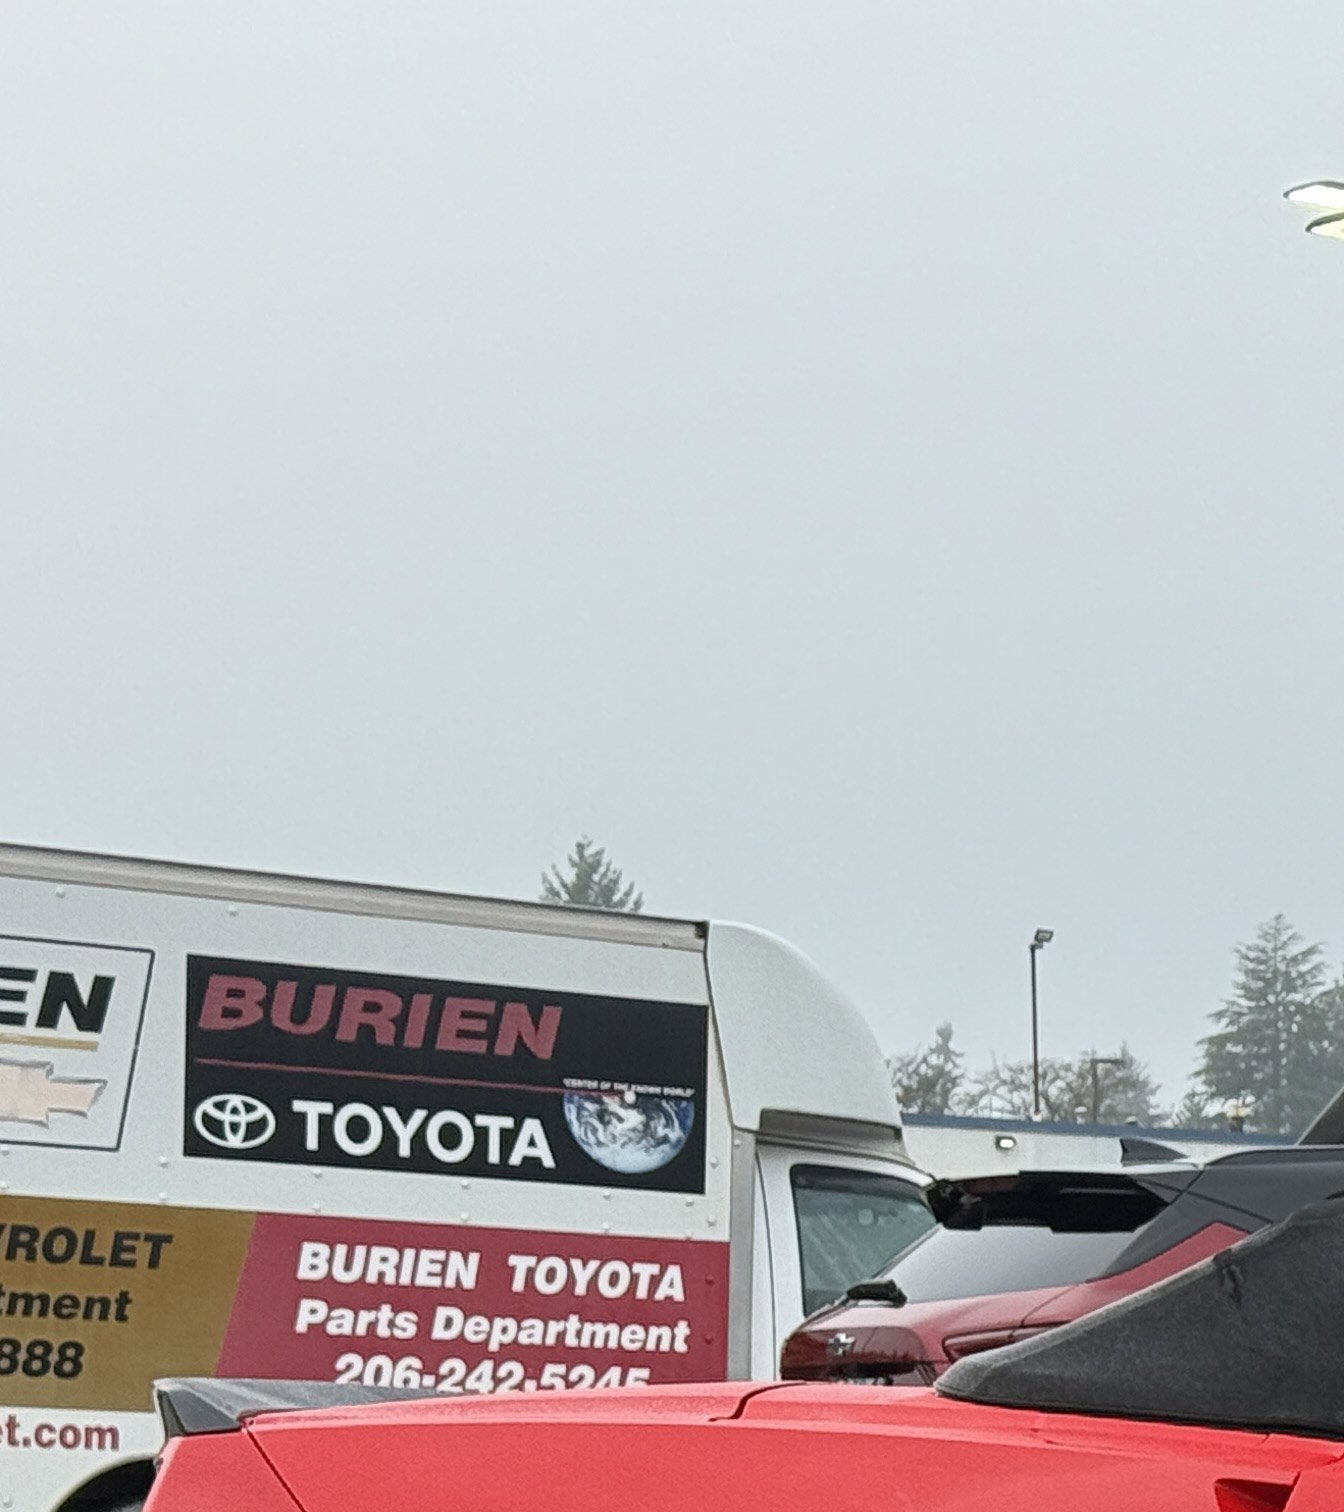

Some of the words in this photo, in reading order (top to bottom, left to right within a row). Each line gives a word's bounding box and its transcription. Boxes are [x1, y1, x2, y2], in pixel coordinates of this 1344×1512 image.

[199, 973, 562, 1060] BURIEN
[292, 1099, 556, 1169] TOYOTA
[296, 1241, 480, 1290] BURIEN
[508, 1254, 685, 1301] TOYOTA
[295, 1298, 418, 1340] Parts
[430, 1305, 690, 1353] Department
[0, 1414, 120, 1450] t.com
